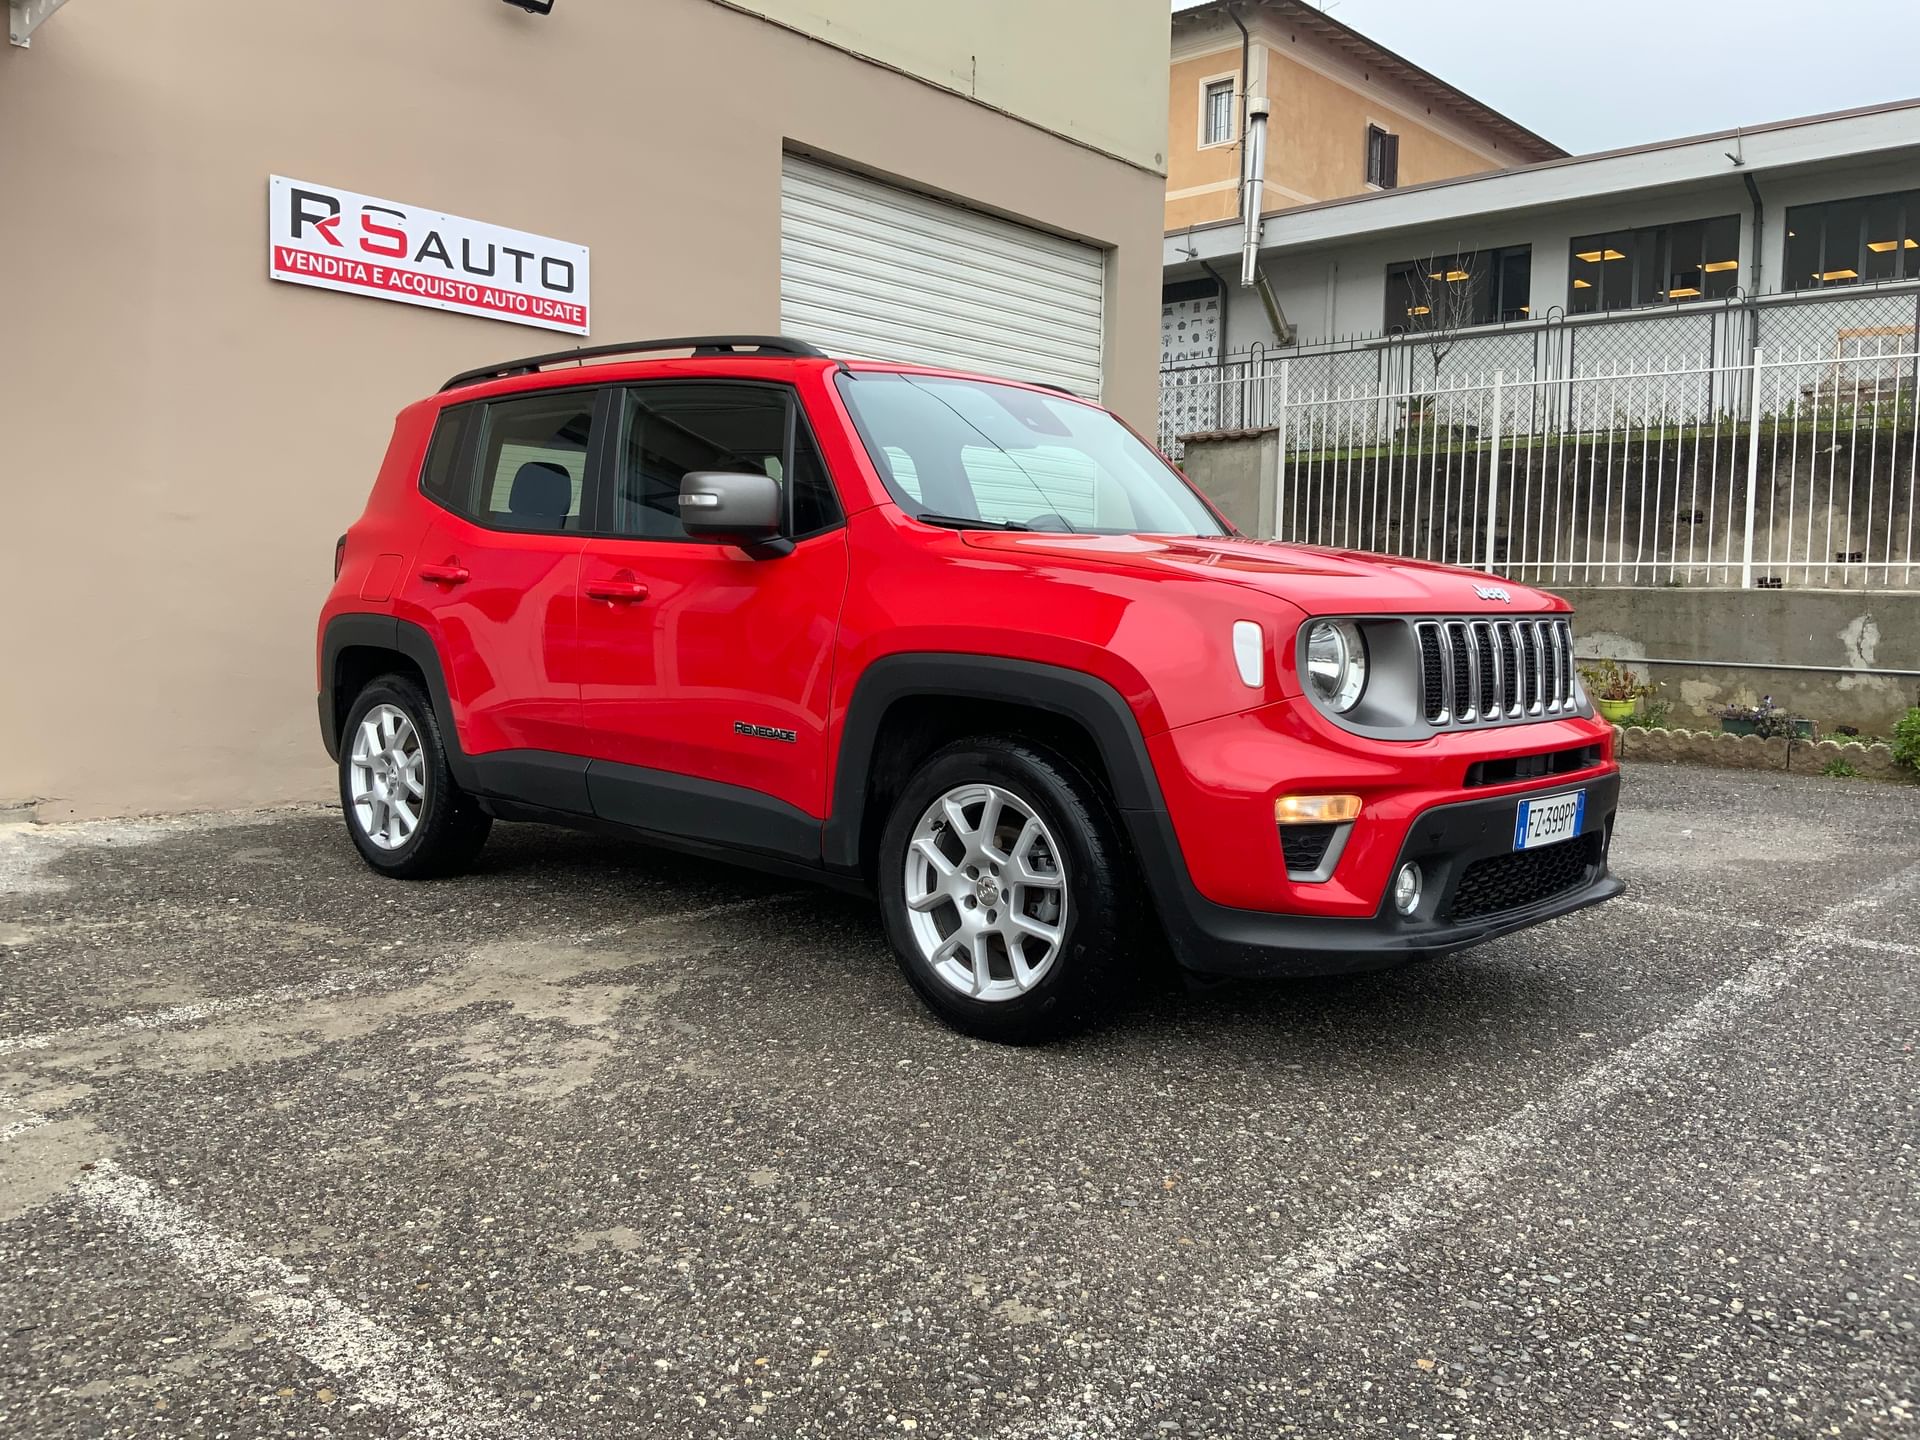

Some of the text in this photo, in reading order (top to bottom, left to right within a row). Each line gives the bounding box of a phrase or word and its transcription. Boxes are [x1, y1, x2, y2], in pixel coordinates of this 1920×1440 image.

[282, 249, 582, 323] VENDITA E ACQUISTO AUTO USATE
[1472, 584, 1510, 604] Jeep
[734, 721, 796, 742] RENEGADE
